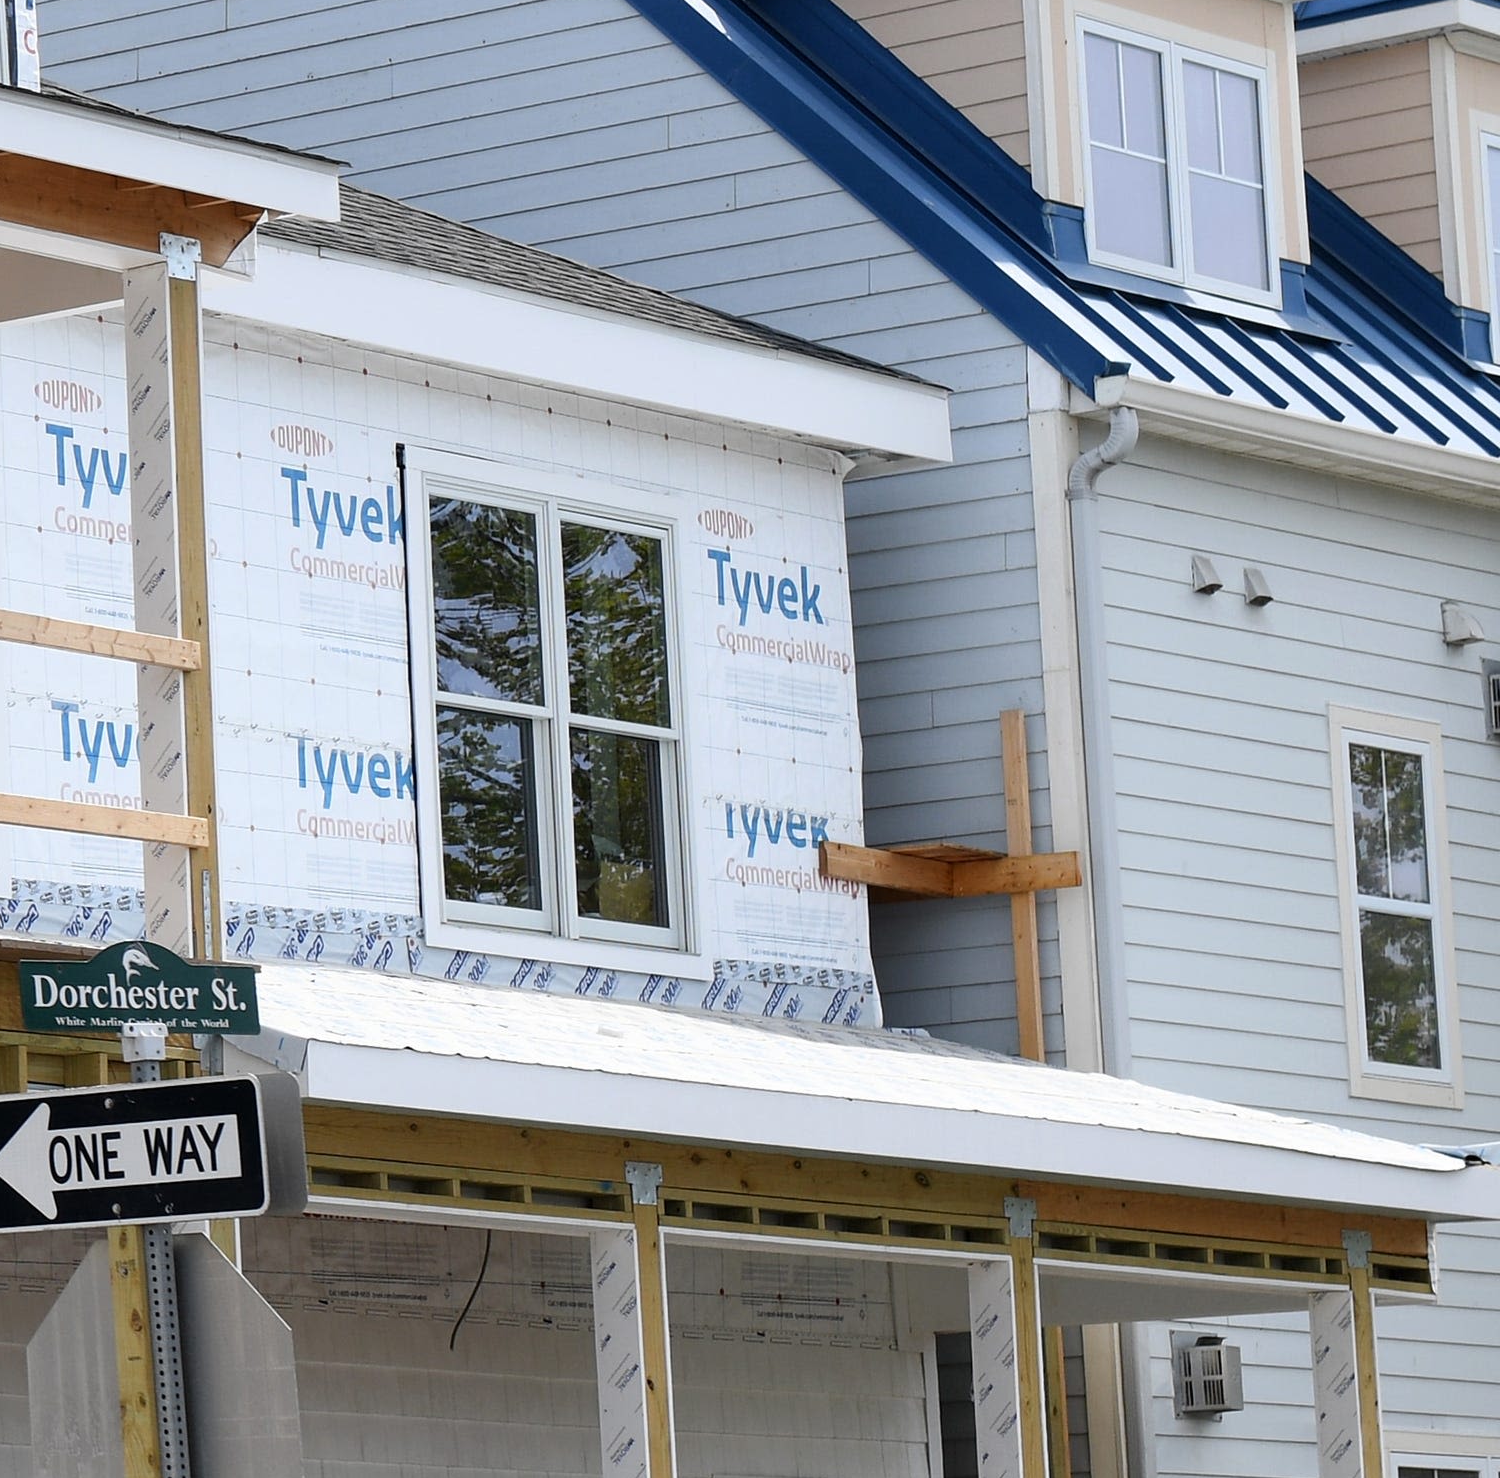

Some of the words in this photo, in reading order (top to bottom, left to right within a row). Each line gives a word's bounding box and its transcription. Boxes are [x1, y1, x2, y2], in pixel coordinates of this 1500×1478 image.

[42, 379, 95, 414] DUPONT
[278, 425, 327, 457] DUPONT
[704, 509, 748, 540] DUPONT
[707, 548, 824, 627] Tyvek
[716, 624, 851, 673] CommercialWrap
[51, 700, 141, 784] Tyv
[288, 734, 416, 810] Tyvek
[31, 973, 200, 1010] Dorchester
[211, 977, 247, 1012] St.
[55, 1016, 86, 1027] White
[90, 1017, 124, 1027] Marlin
[167, 1018, 179, 1027] of
[181, 1019, 198, 1028] the
[200, 1019, 230, 1028] World
[50, 1130, 125, 1185] ONE
[143, 1122, 225, 1176] WAY
